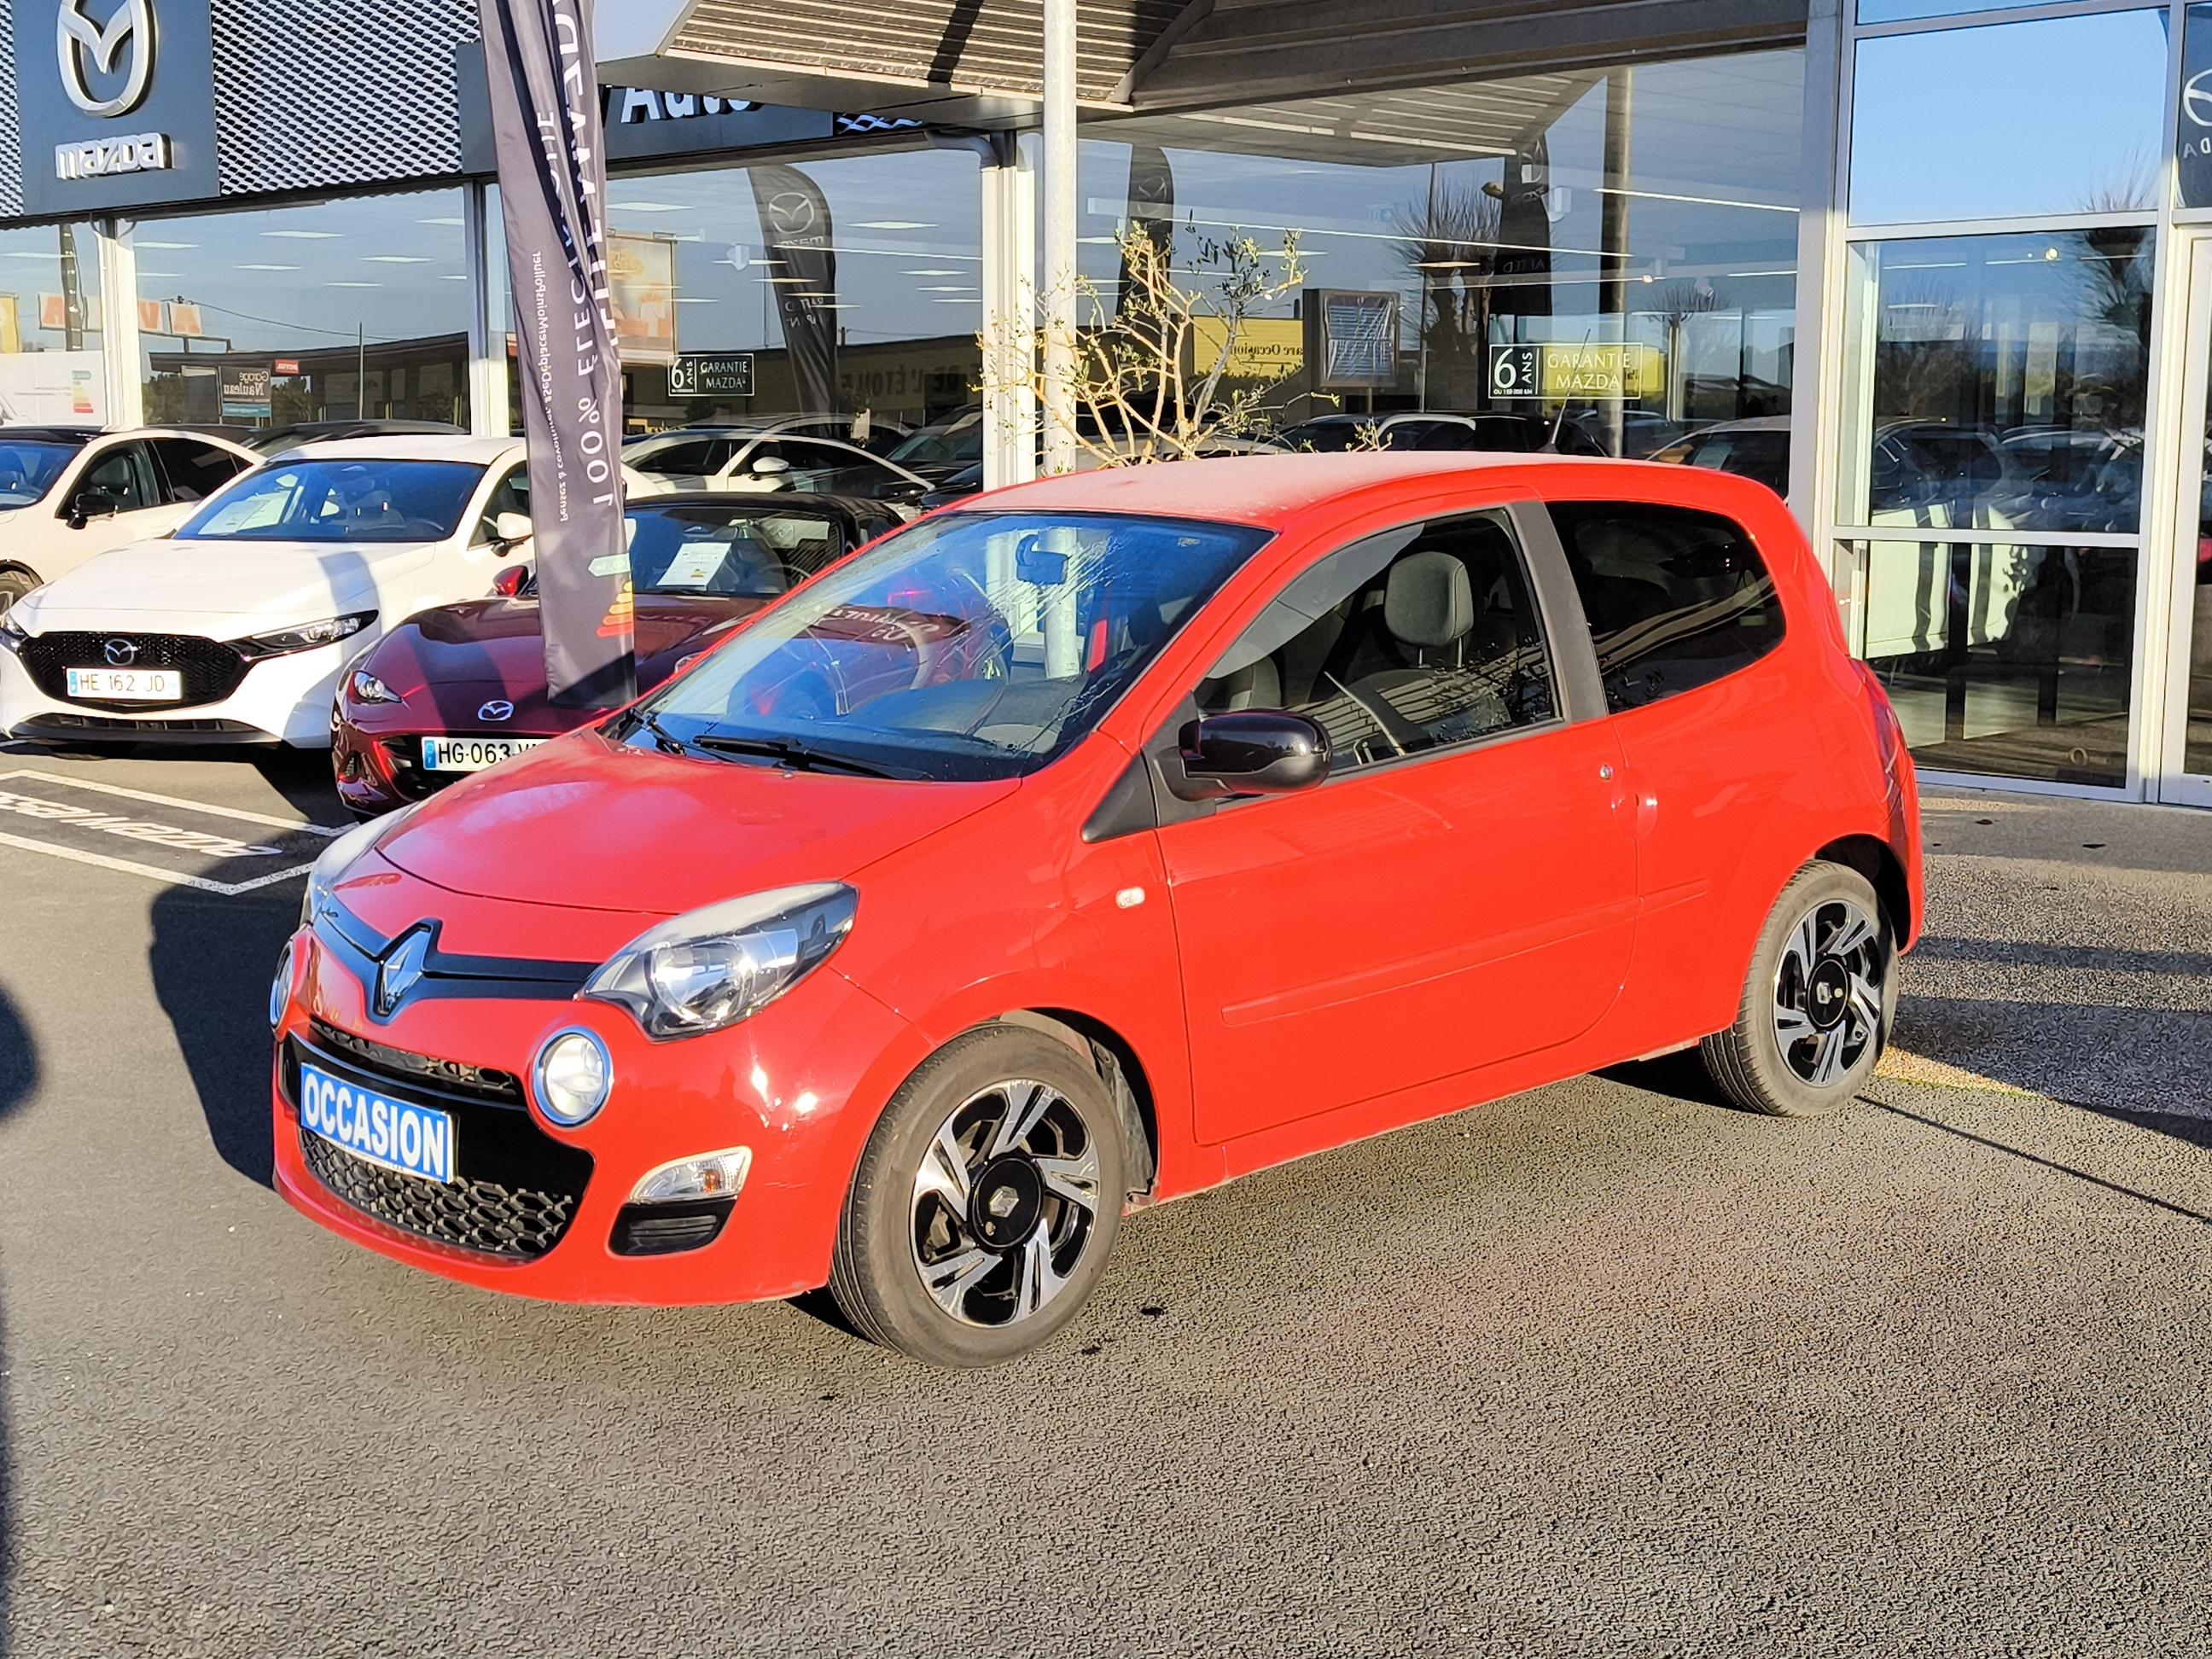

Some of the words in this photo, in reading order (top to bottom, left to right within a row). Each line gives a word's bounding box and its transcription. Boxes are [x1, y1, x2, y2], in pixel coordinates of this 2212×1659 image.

[55, 132, 164, 179] mazda
[671, 358, 684, 389] 6
[701, 361, 748, 374] GARANTIE
[1494, 348, 1516, 389] 6
[1522, 352, 1533, 384] ANS
[1547, 352, 1632, 369] GARANTIE
[706, 376, 743, 389] MAZDA
[1556, 373, 1621, 390] MAZDA
[305, 1073, 444, 1177] OCCASION
